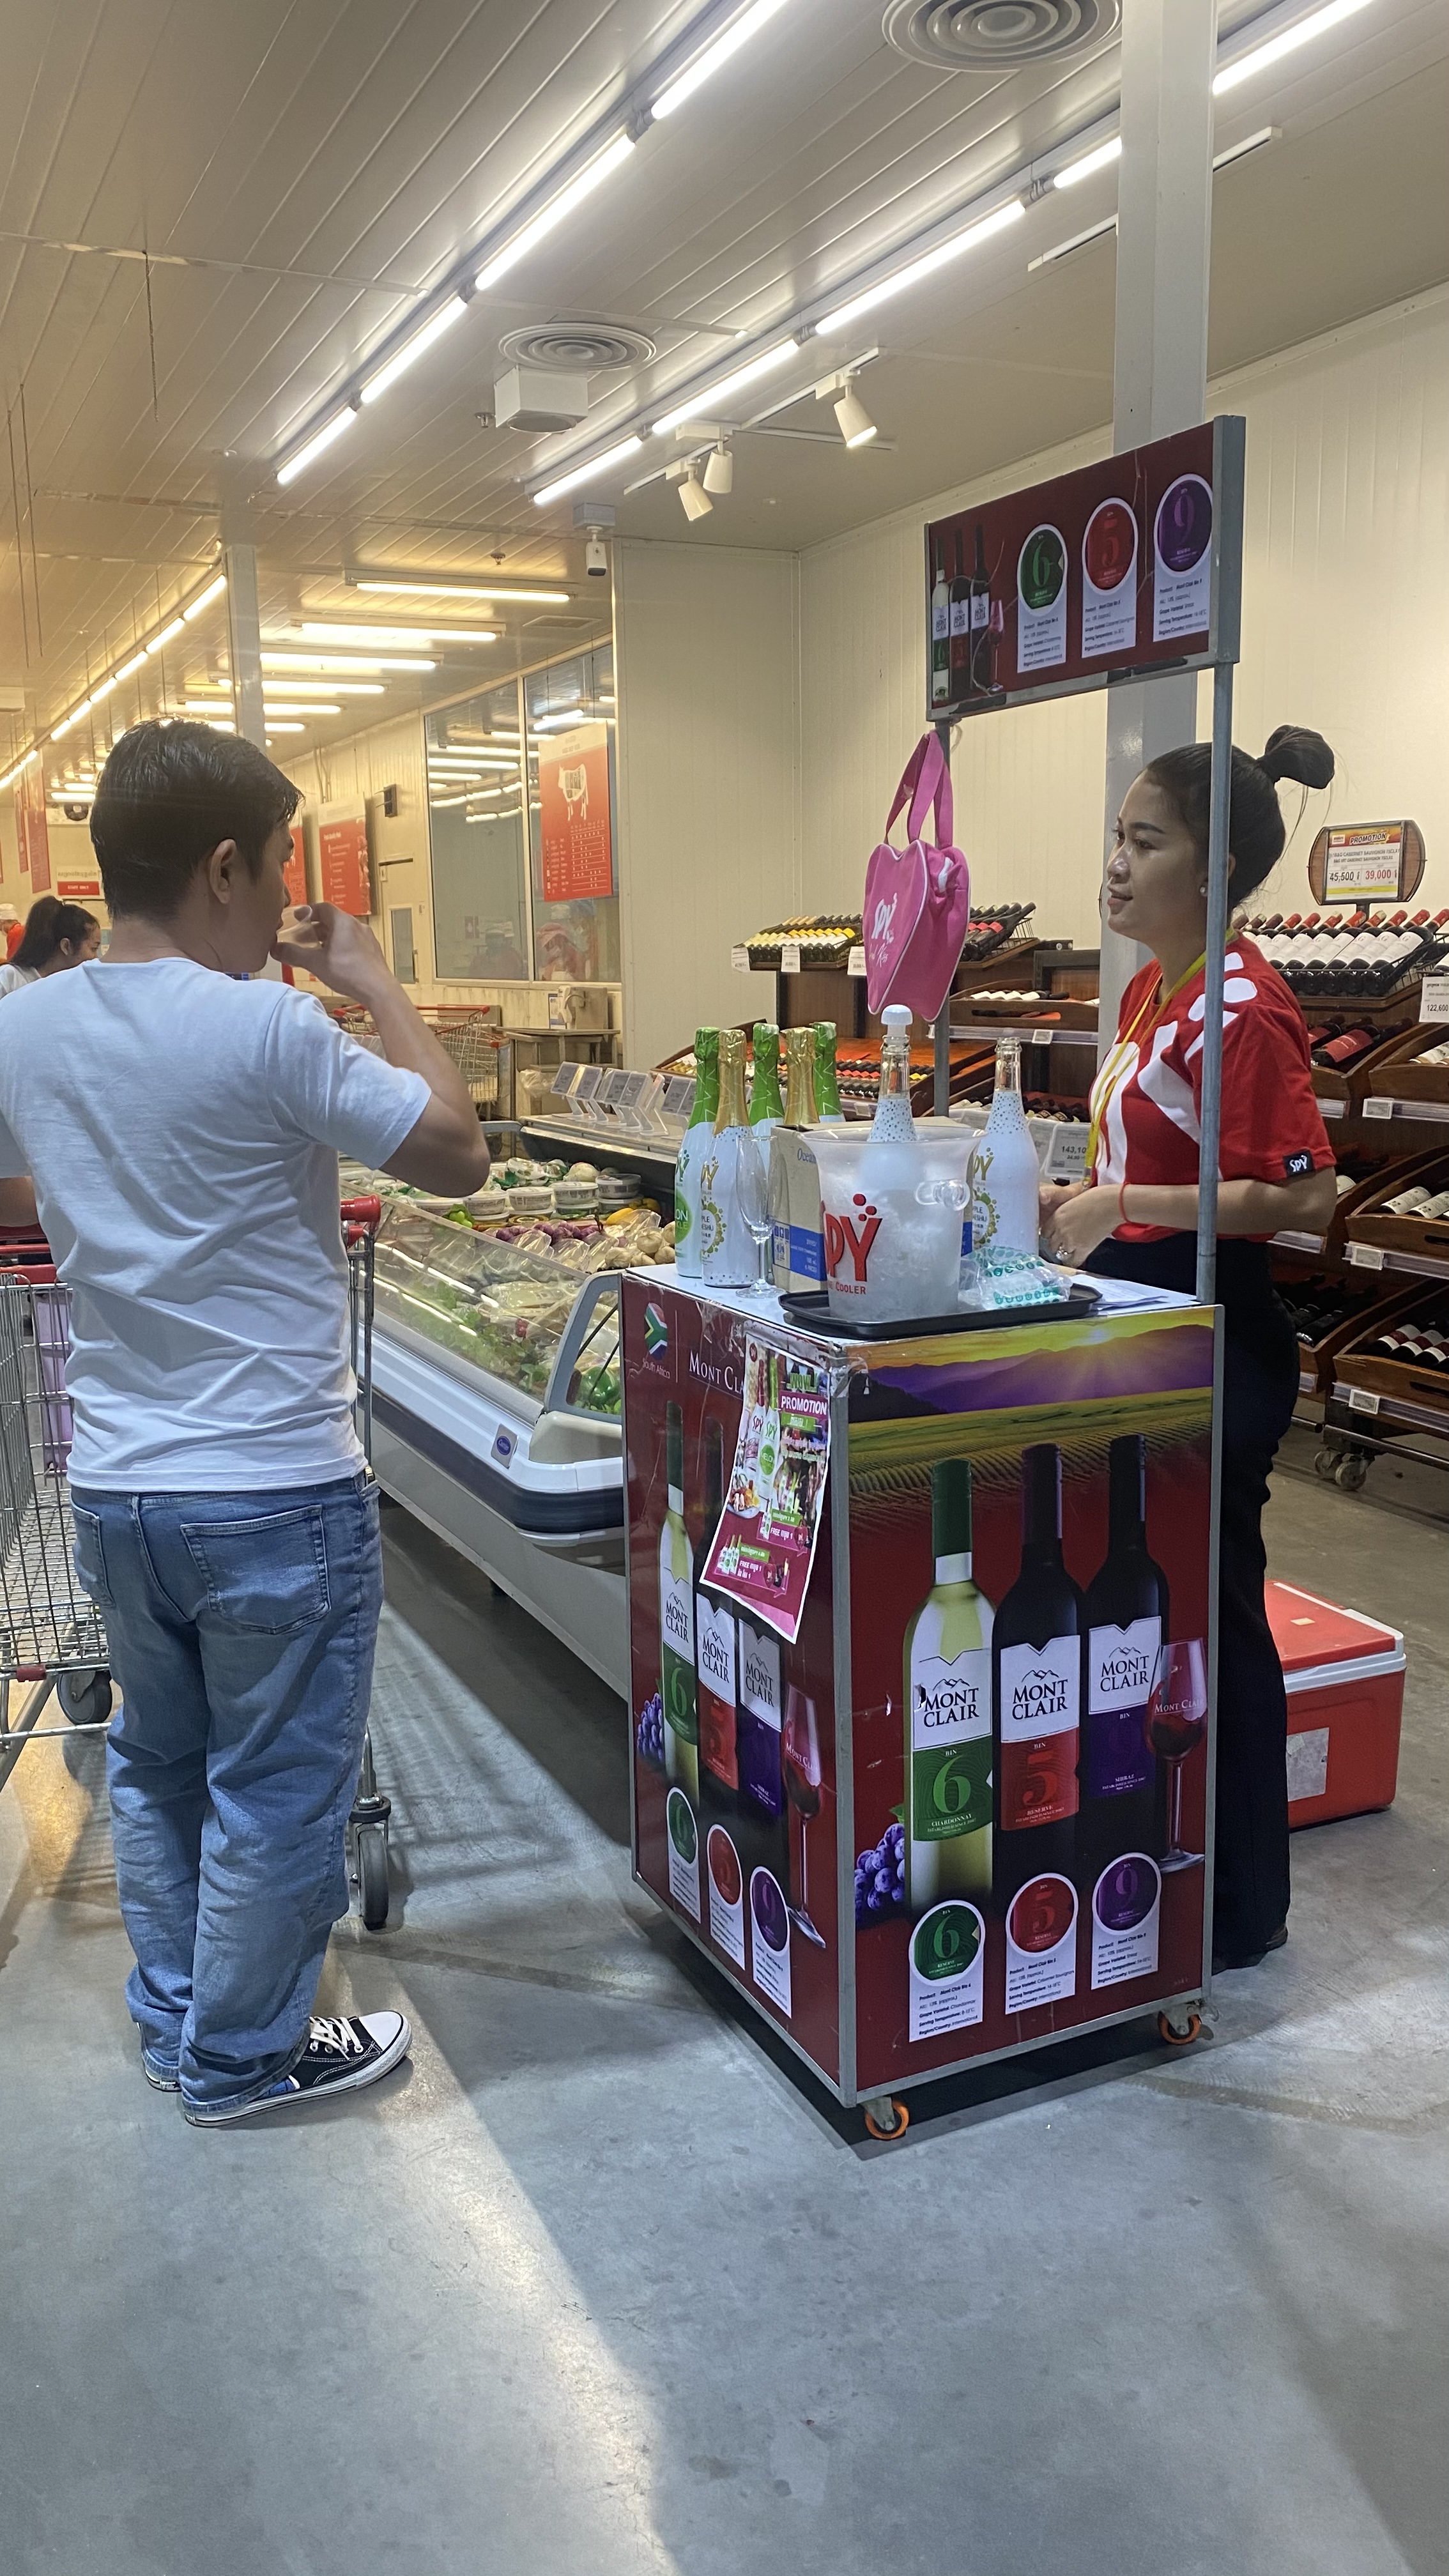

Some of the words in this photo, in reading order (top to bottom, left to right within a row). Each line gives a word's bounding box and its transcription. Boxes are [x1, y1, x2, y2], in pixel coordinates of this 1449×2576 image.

[1032, 539, 1050, 587] 6
[1350, 833, 1386, 844] PROMOTION
[1330, 871, 1354, 882] 45,500
[1365, 870, 1392, 881] 39,000
[1062, 1146, 1087, 1154] 143,10
[1289, 1154, 1307, 1172] SPY
[836, 1282, 866, 1295] COOLER
[642, 1358, 656, 1372] South
[656, 1365, 670, 1379] Africa
[689, 1349, 721, 1384] MONT
[724, 1366, 744, 1395] CLA
[781, 1395, 827, 1415] PROMOTION
[753, 1415, 764, 1432] SPY
[765, 1421, 778, 1440] SPY
[770, 1528, 780, 1536] FREE
[740, 1560, 749, 1568] FREE
[666, 1600, 688, 1627] MONT
[666, 1616, 689, 1643] CLAIR
[703, 1635, 729, 1667] MONT
[703, 1653, 730, 1683] CLAIR
[746, 1661, 773, 1691] MONT
[1101, 1655, 1149, 1677] MONT
[671, 1667, 687, 1716] 6
[746, 1676, 774, 1707] CLAIR
[1013, 1679, 1068, 1704] MONT
[1100, 1671, 1149, 1692] CLAIR
[924, 1687, 979, 1712] MONT
[1012, 1696, 1068, 1720] CLAIR
[1154, 1704, 1179, 1713] MONT
[924, 1705, 979, 1728] CLAIR
[933, 1756, 971, 1813] 6
[1023, 1751, 1058, 1805] 5
[1115, 1774, 1135, 1782] SHIRAZ
[931, 1813, 972, 1827] CHARDONNAY
[1027, 1805, 1053, 1816] RESERVE
[1116, 1869, 1138, 1907] 9
[933, 1913, 960, 1958] 6
